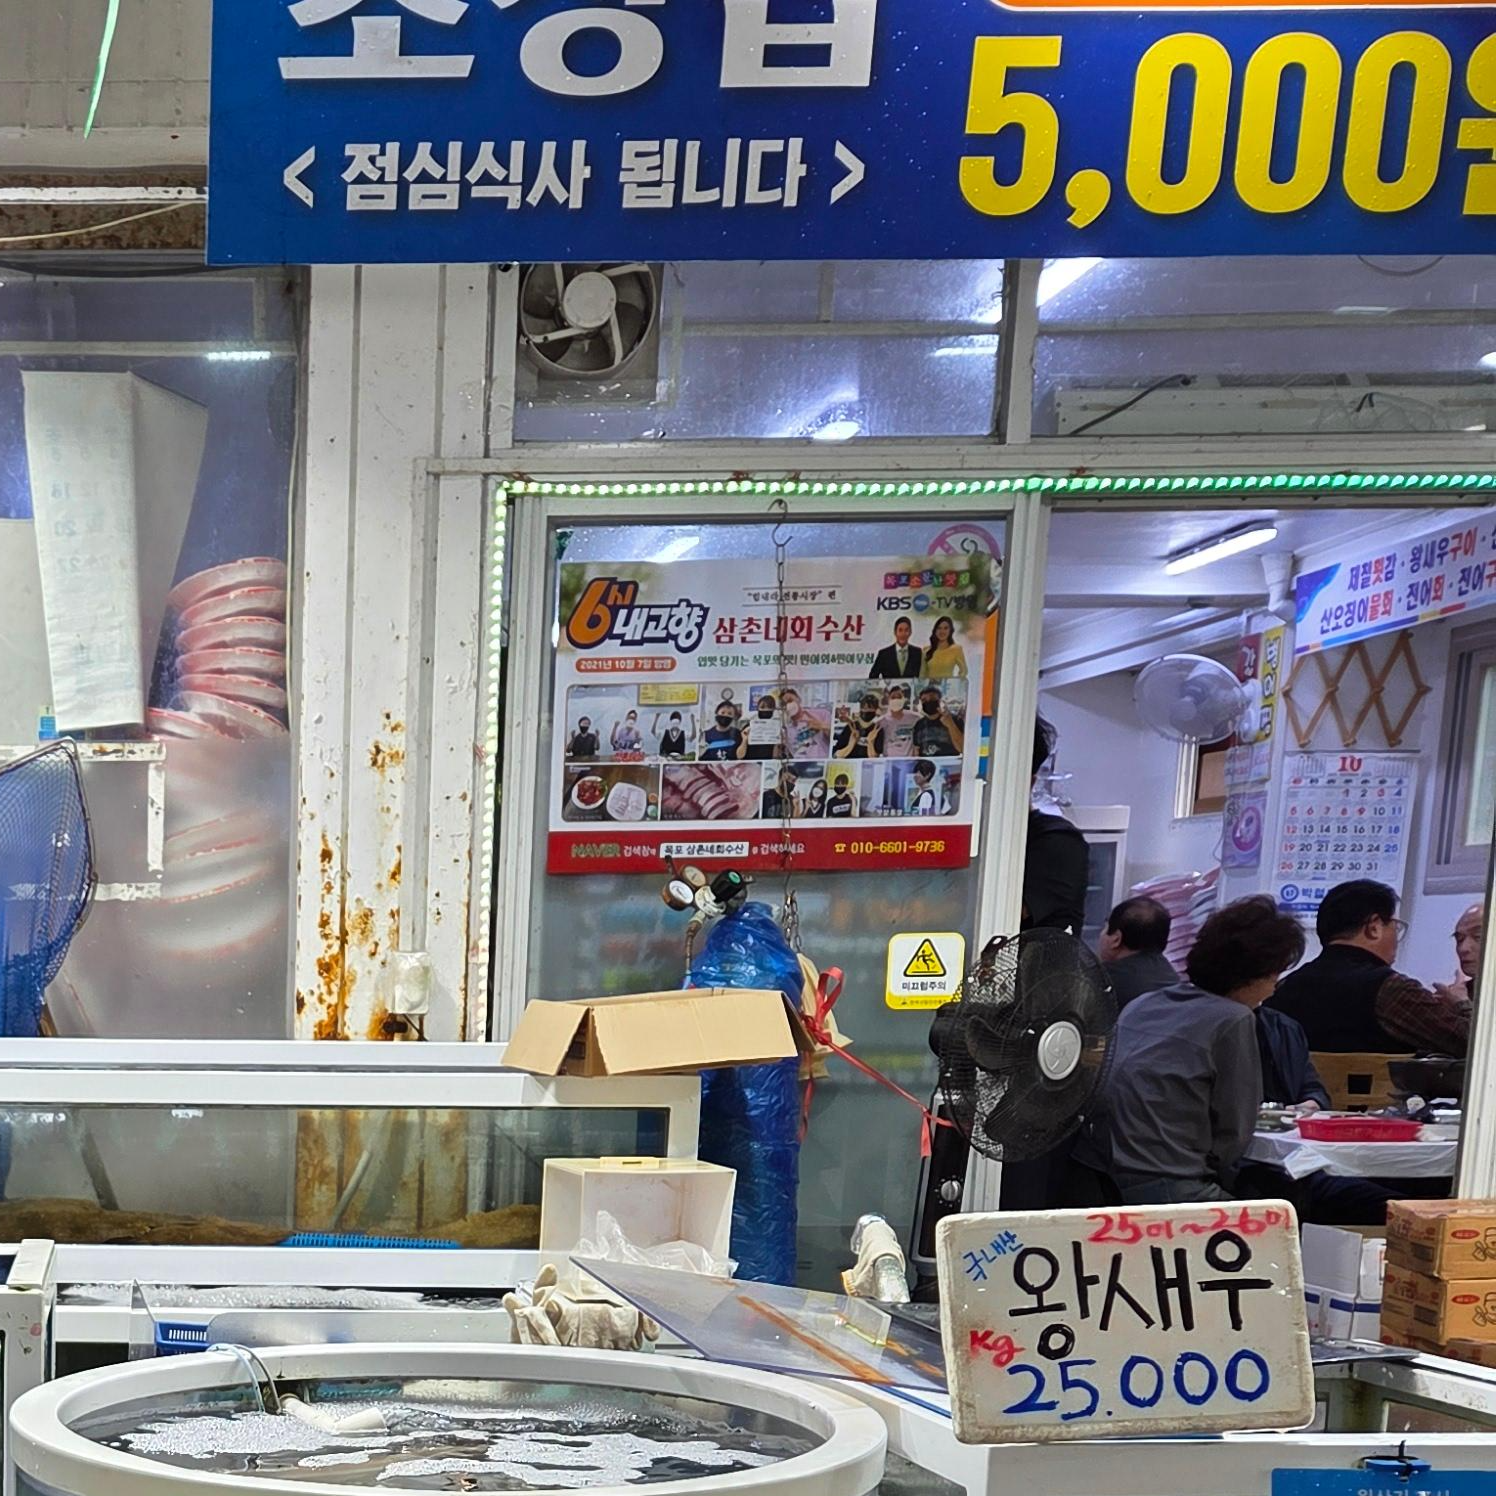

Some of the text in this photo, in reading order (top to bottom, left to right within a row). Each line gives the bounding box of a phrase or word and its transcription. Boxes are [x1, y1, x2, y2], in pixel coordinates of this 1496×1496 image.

[340, 137, 807, 211] 점심식사 됩니다
[1348, 552, 1397, 591] 제철횟감
[1410, 527, 1478, 573] 왕새우구이
[877, 596, 912, 611] KBS
[1320, 589, 1394, 634] 산오징어물회
[1406, 574, 1445, 611] 전어회
[568, 577, 638, 649] 6시
[612, 600, 707, 651] 내고향
[712, 614, 866, 645] 삼촌네회수산
[580, 661, 612, 671] 2021년
[615, 660, 635, 670] 10월
[638, 659, 653, 669] 7일
[1338, 755, 1363, 772] 10
[1374, 806, 1385, 816] 10
[1392, 806, 1402, 816] 11
[1286, 825, 1399, 834] 12 13 14 15 16 17 18
[571, 843, 621, 858] NAVER
[850, 840, 945, 854] 010-6601-9736
[1284, 843, 1398, 853] 19 20 21 22 23 24 25
[1281, 862, 1378, 871] 26 27 28 29 30 31
[901, 981, 947, 991] 미끄럼주의
[1009, 1228, 1274, 1360] 왕새우
[1002, 1348, 1271, 1421] 25.000
